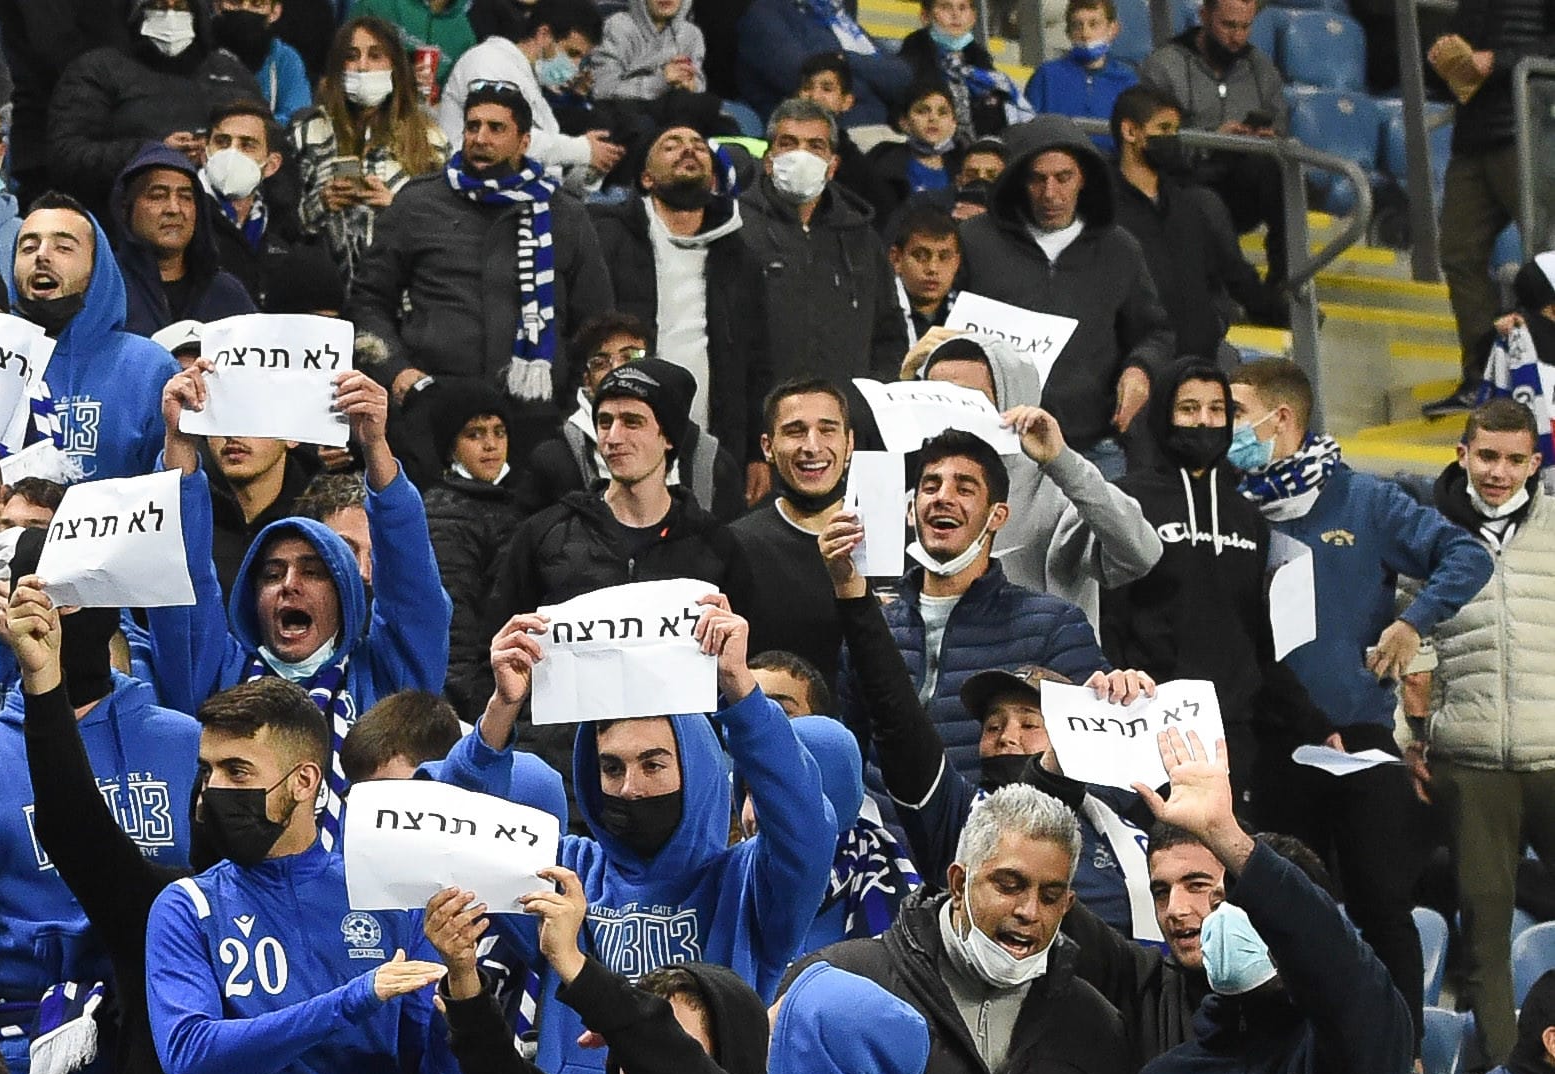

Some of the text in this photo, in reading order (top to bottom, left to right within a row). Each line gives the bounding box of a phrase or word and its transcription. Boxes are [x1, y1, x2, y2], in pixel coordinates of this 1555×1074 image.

[214, 343, 340, 370] לא תרצח
[49, 501, 164, 543] לא תרצח
[552, 608, 701, 643] לא תרצח
[1067, 699, 1200, 738] לא תרצח
[376, 809, 539, 847] לא תרצח
[219, 936, 289, 998] 20
